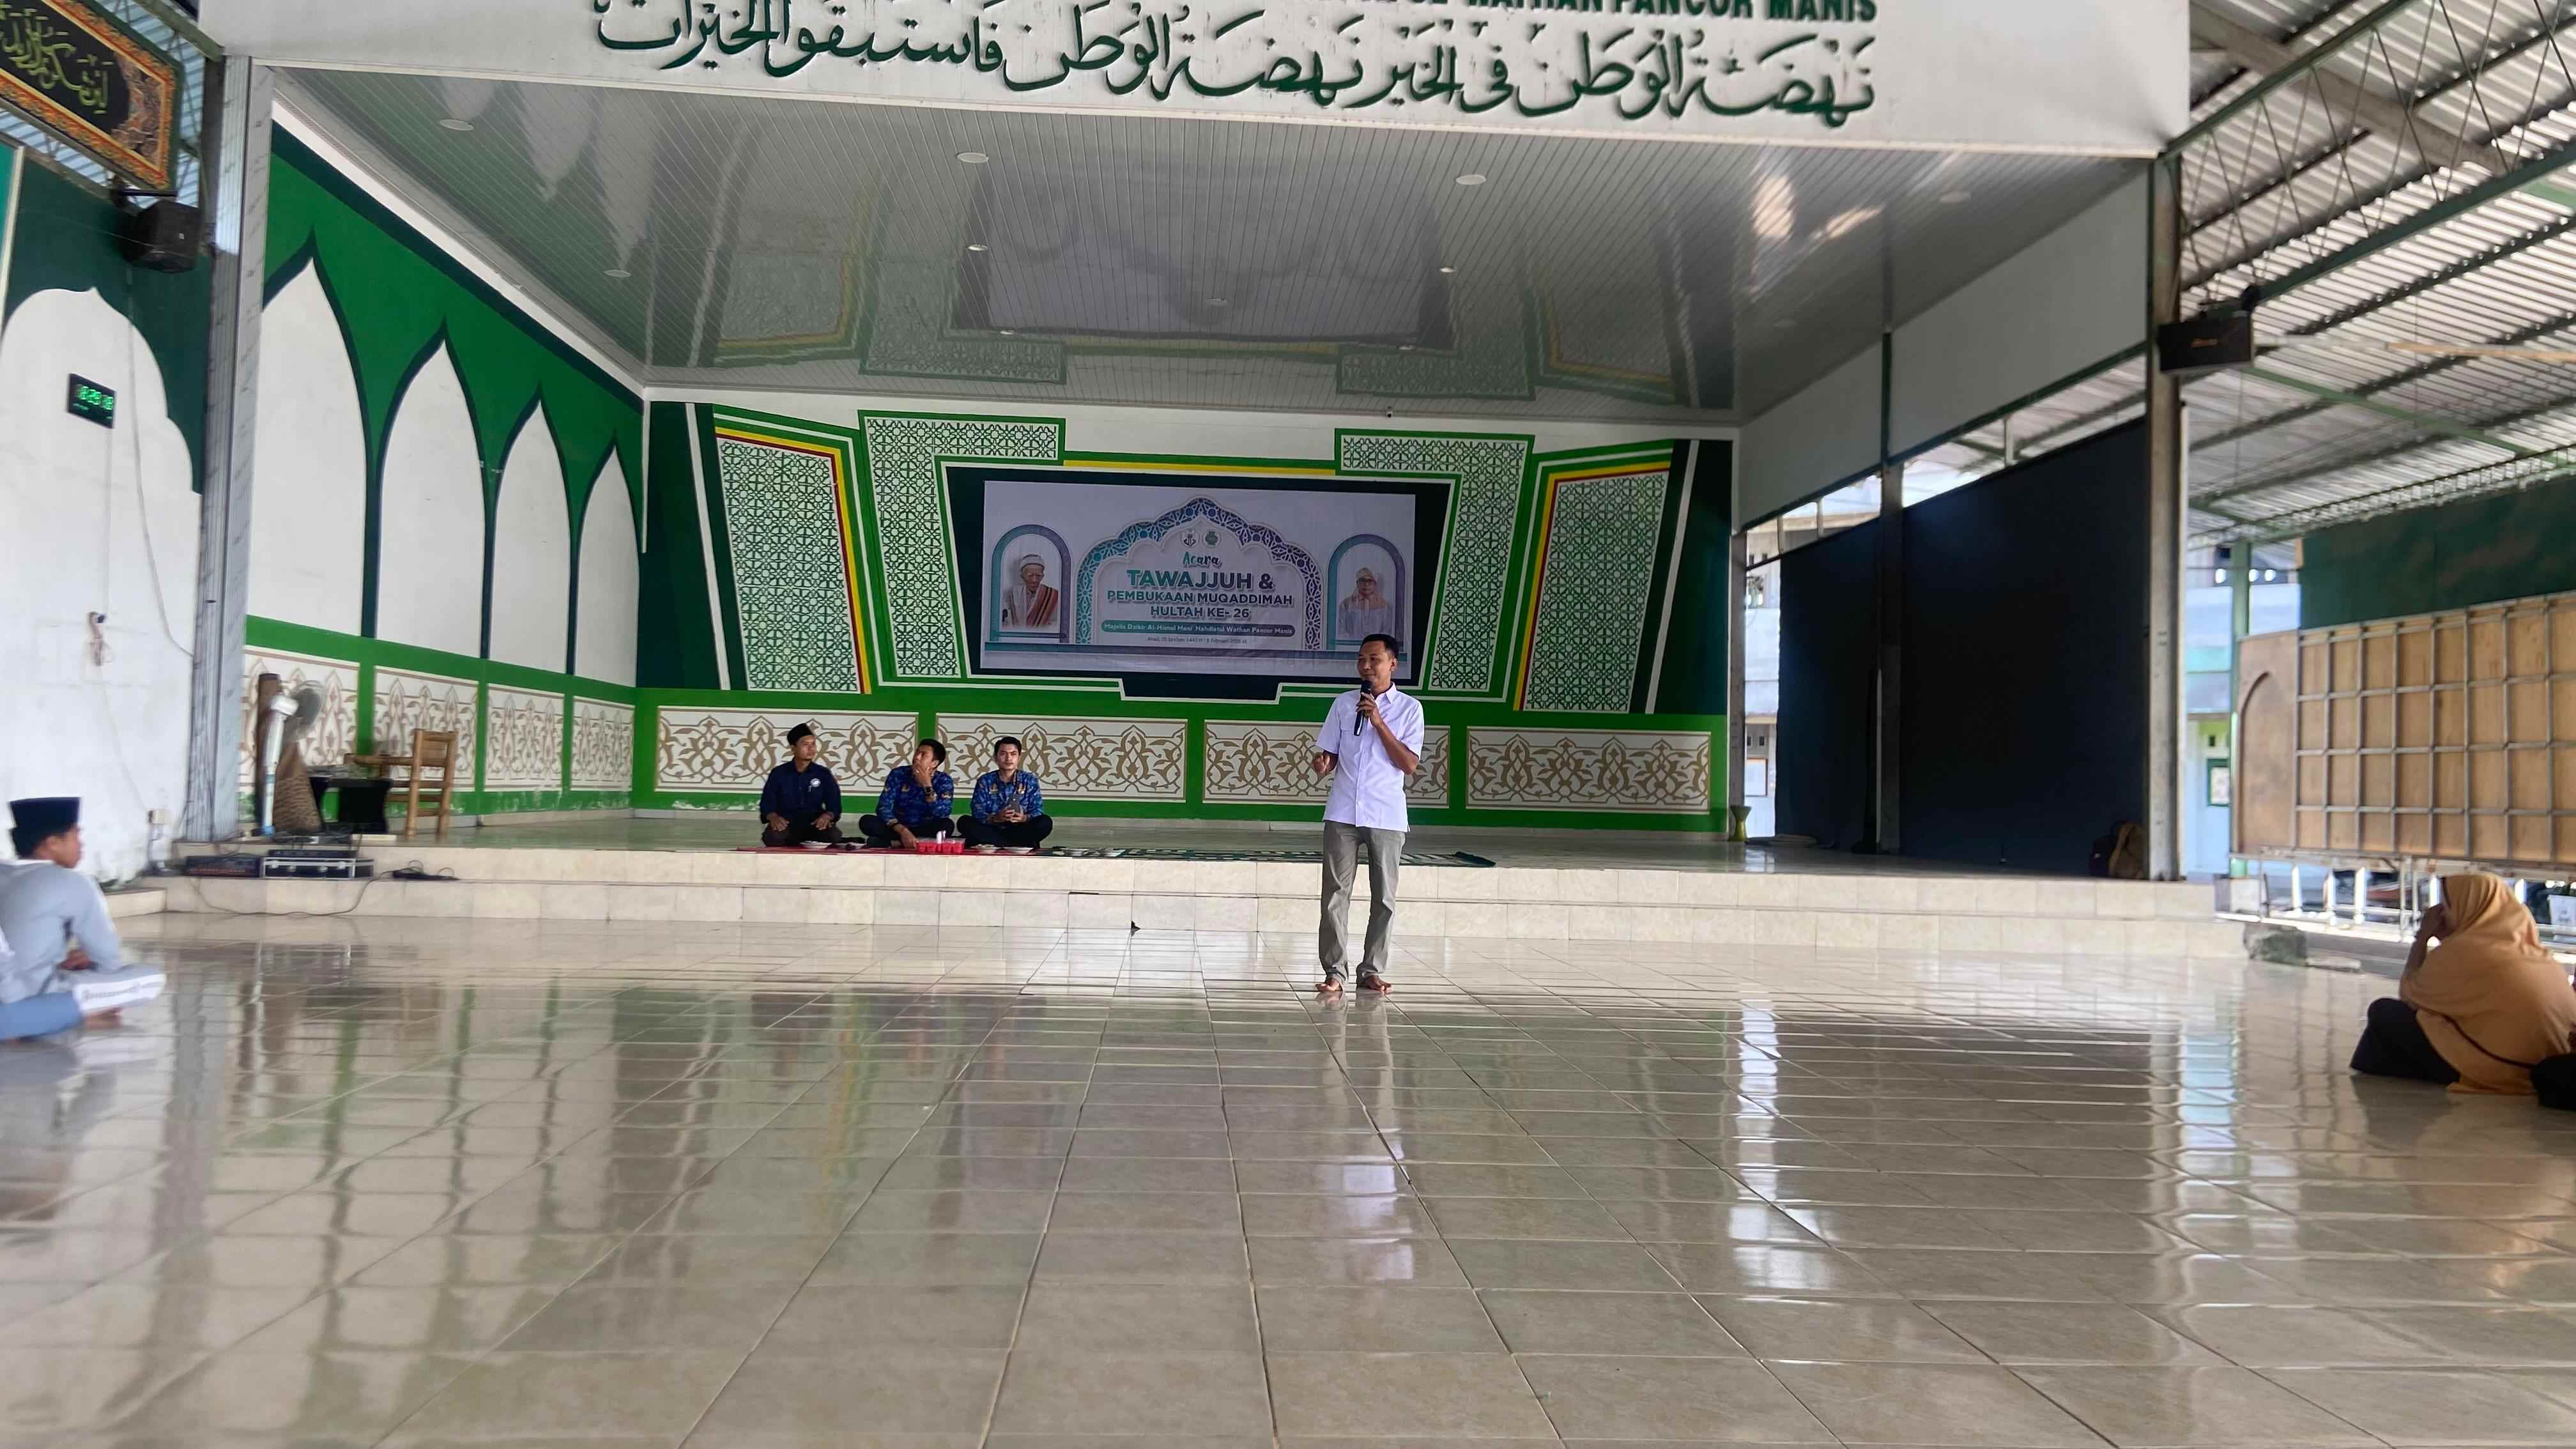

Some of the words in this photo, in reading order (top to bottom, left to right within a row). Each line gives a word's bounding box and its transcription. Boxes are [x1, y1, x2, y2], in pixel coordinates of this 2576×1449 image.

[1768, 0, 1876, 22] MANIS
[1183, 551, 1222, 567] Acara
[1126, 569, 1252, 589] TAWAJJUH
[1259, 572, 1275, 590] &
[1107, 590, 1193, 603] PEMBUKAAN
[1197, 592, 1292, 605] MUQADDIMAH
[1151, 605, 1204, 617] HULTAH
[1234, 608, 1250, 618] 26
